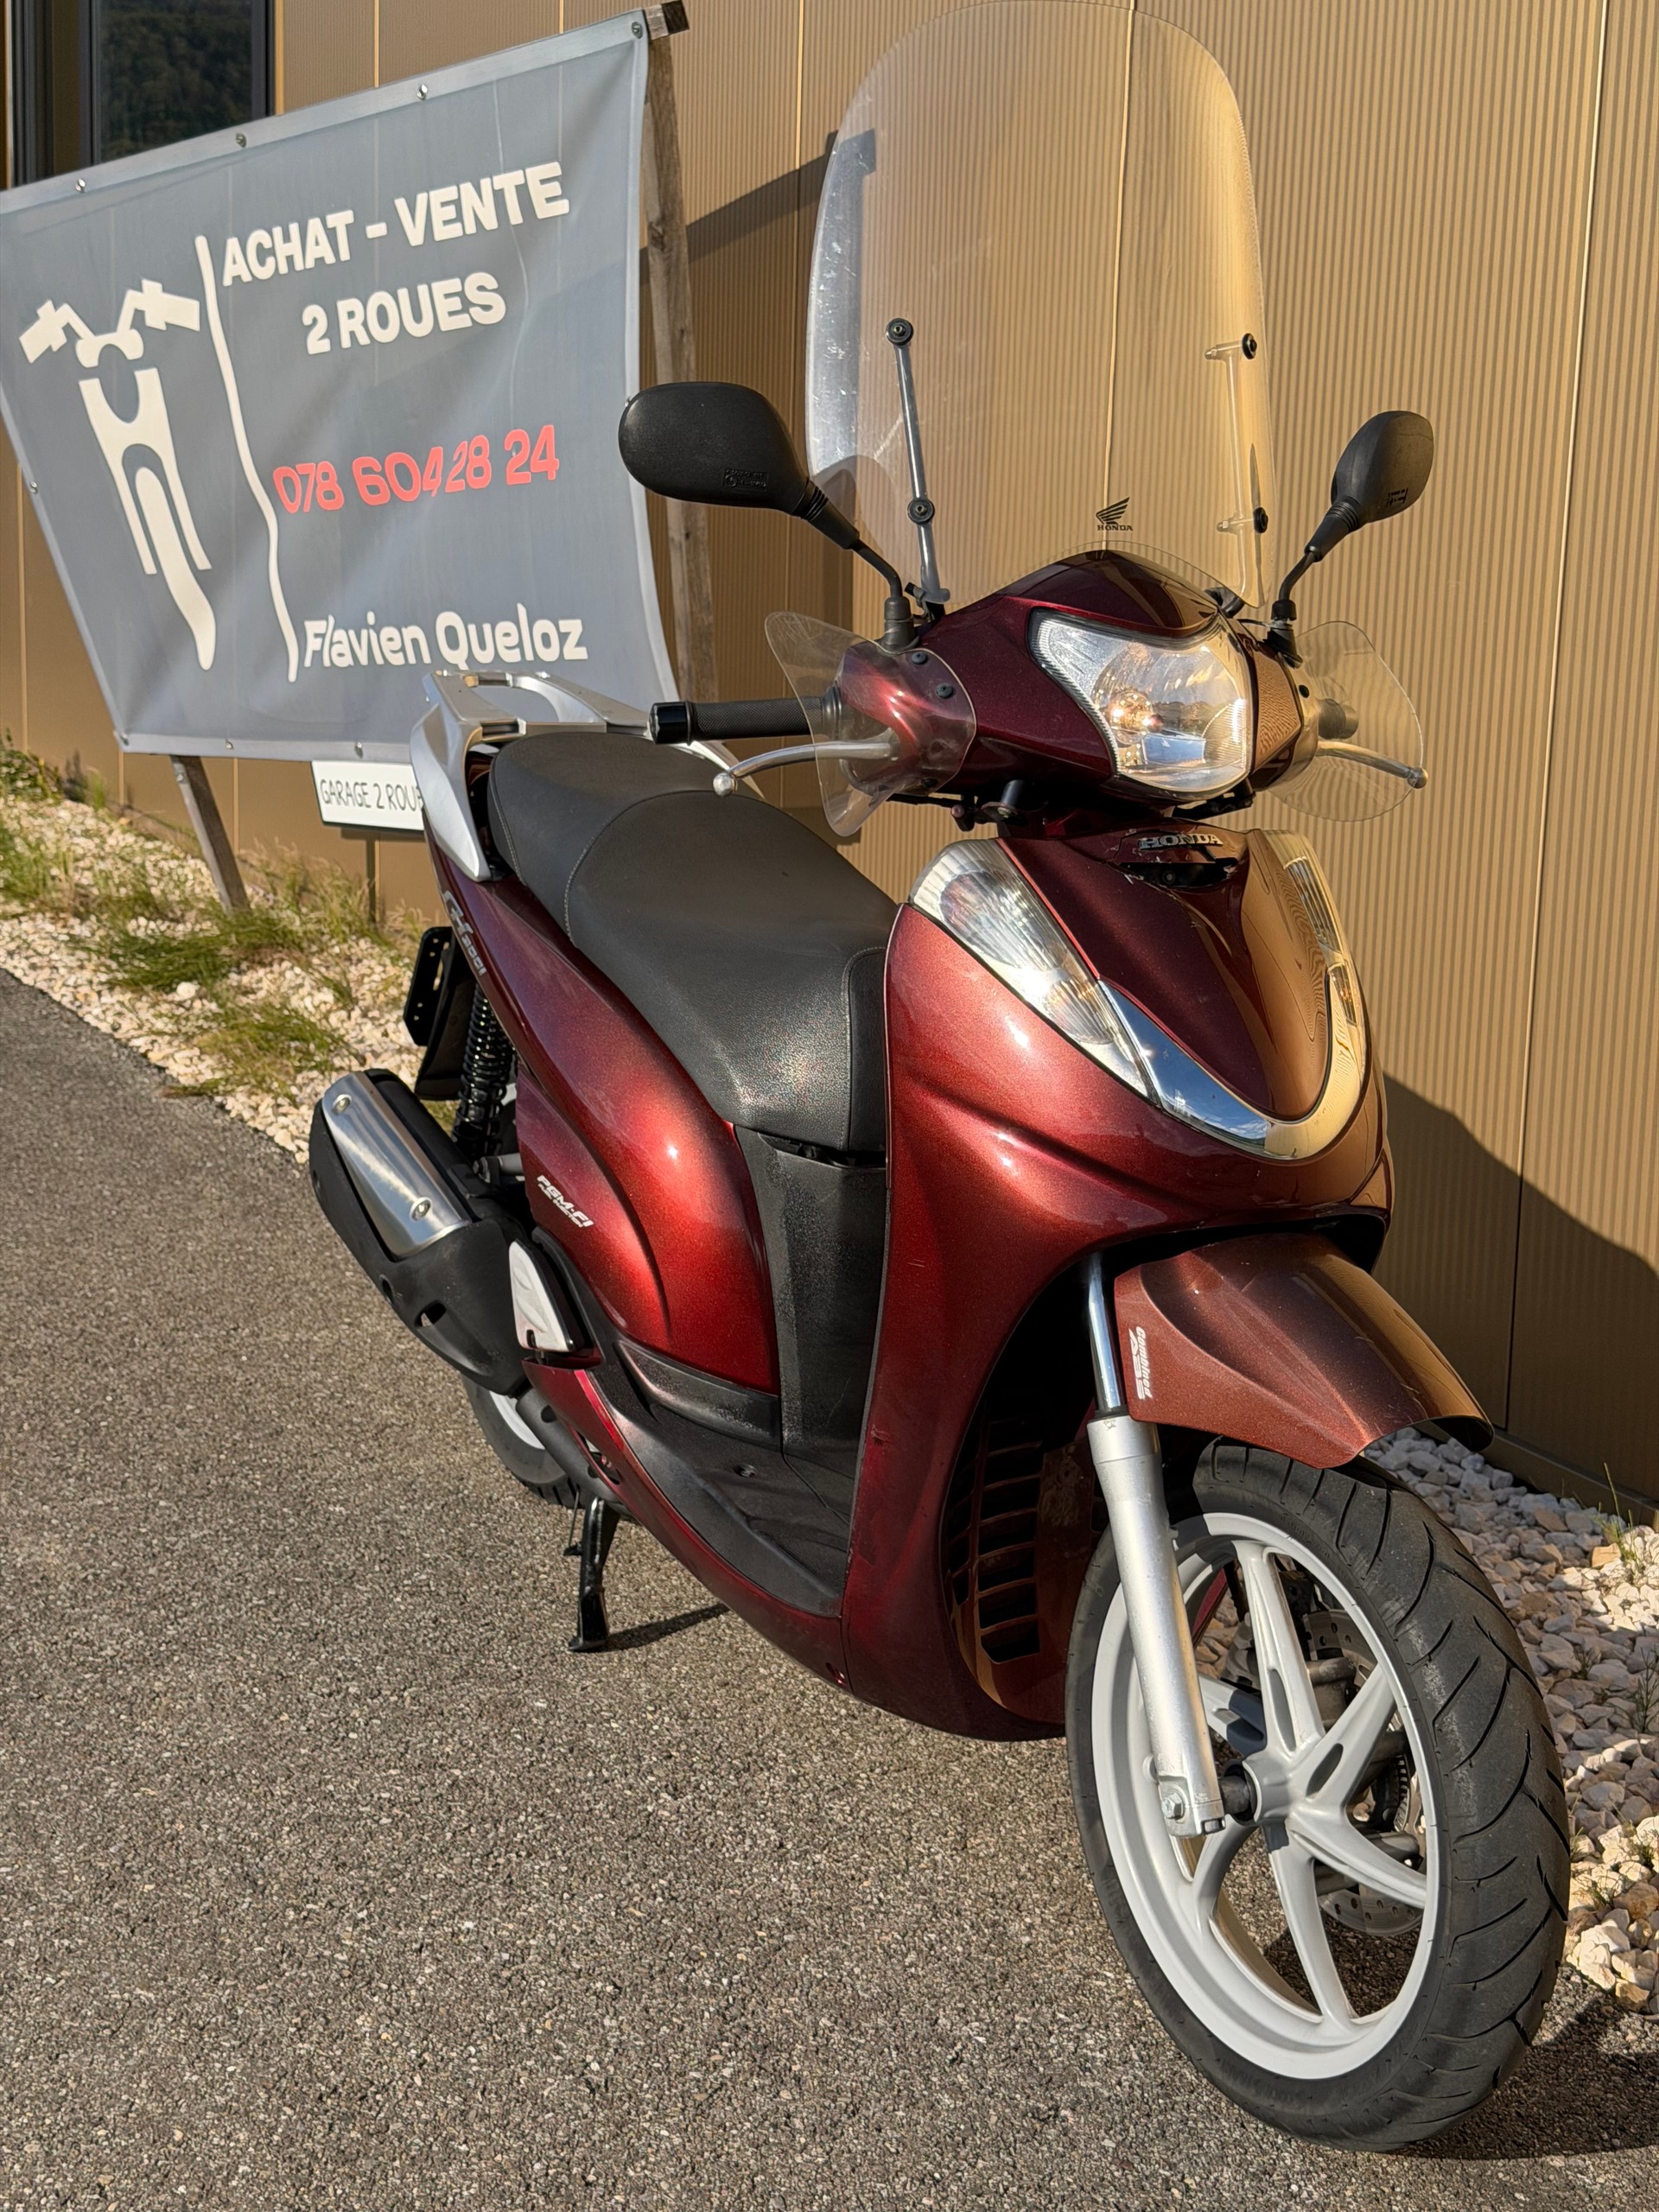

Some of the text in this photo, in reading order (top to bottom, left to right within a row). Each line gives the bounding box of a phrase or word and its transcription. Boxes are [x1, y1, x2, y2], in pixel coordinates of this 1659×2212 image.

[223, 162, 570, 286] ACHAT - VENTE
[302, 272, 506, 355] 2 ROUES
[272, 461, 344, 514] 078
[504, 424, 560, 486] 24
[304, 602, 588, 671] Flavien Queloz
[320, 779, 372, 809] GARAGE
[373, 783, 385, 810] 2
[1139, 833, 1224, 850] HONDA
[1128, 1328, 1146, 1400] ABS
